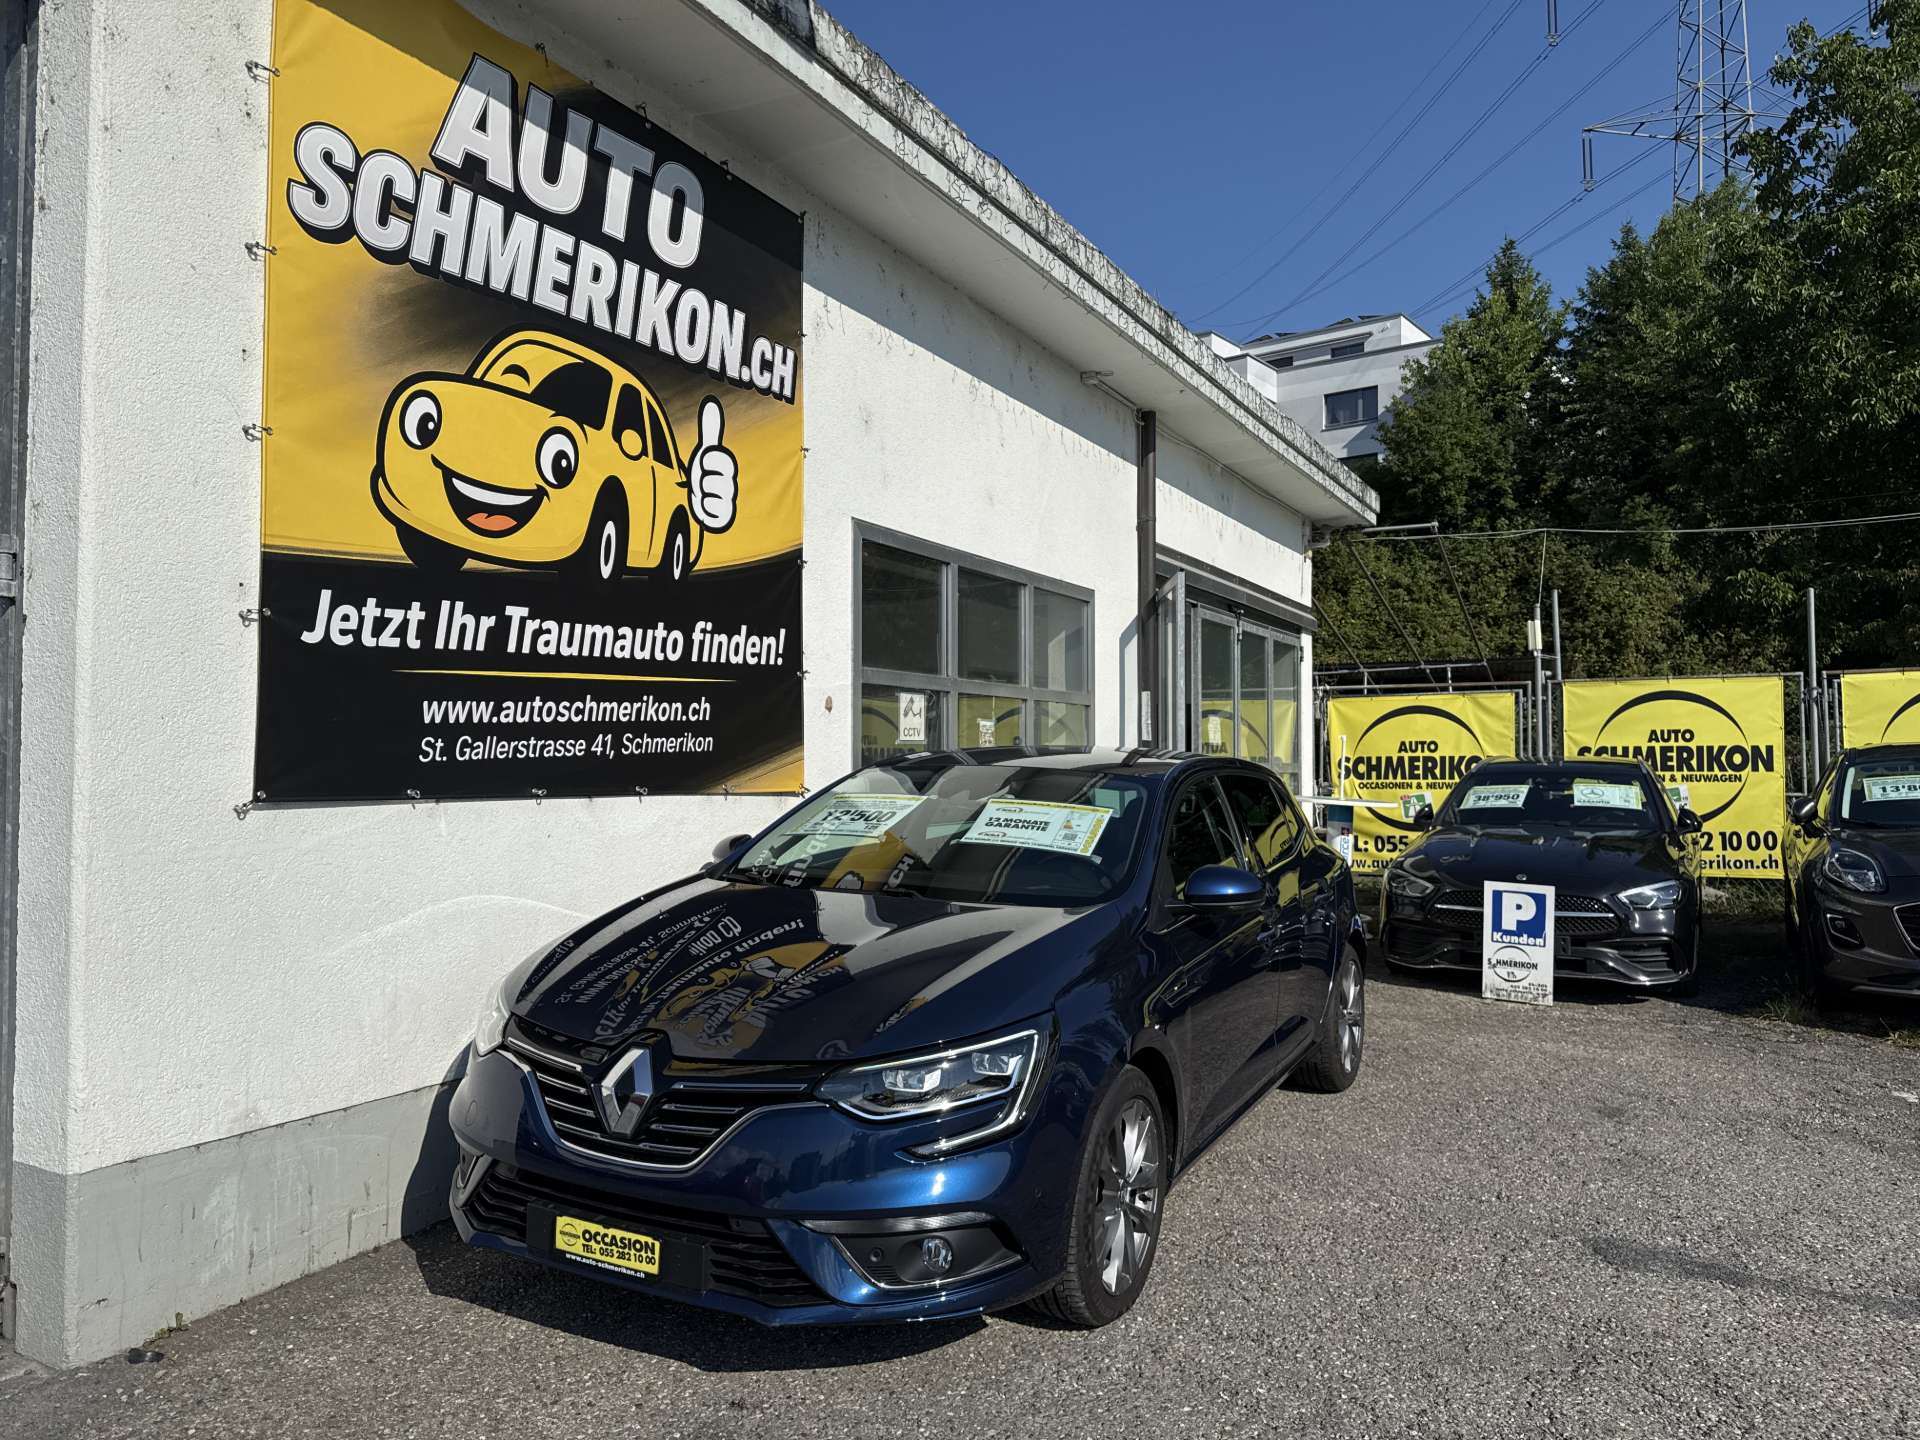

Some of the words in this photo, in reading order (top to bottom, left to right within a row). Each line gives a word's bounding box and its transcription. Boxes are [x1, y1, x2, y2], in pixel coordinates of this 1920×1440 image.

[431, 54, 705, 269] AUTO
[289, 122, 796, 400] SCHMERIKON.CH
[301, 589, 427, 649] Jetzt
[434, 599, 496, 652] Ihr
[504, 605, 684, 662] Traumauto
[691, 621, 786, 666] finden!
[422, 694, 711, 724] www.autoschmerikon.ch
[903, 727, 920, 737] CCTV
[1647, 729, 1695, 743] AUTO
[418, 737, 448, 763] St.
[455, 735, 588, 761] Gallerstrasse
[592, 734, 615, 759] 41,
[621, 732, 714, 755] Schmerikon
[1397, 740, 1439, 754] AUTO
[1337, 755, 1486, 781] SCHMERIKO
[1358, 781, 1413, 790] OCCASIONEN
[1416, 781, 1423, 790] &
[1426, 781, 1457, 790] NEUW
[1669, 774, 1678, 783] &
[1681, 773, 1743, 783] NEUWAGEN
[1879, 784, 1920, 793] 13'8
[985, 822, 1049, 832] GARANTIE
[1002, 817, 1051, 827] MONATE
[1718, 831, 1743, 851] 10
[1746, 831, 1778, 851] 00
[1699, 853, 1779, 870] erikon.ch
[1501, 892, 1537, 931] P
[1493, 932, 1544, 945] Kunden
[581, 1229, 656, 1256] OCCASION
[581, 1243, 597, 1255] TEL:
[599, 1247, 615, 1258] 055
[616, 1251, 632, 1262] 282
[634, 1254, 643, 1263] 10
[645, 1255, 656, 1266] 00
